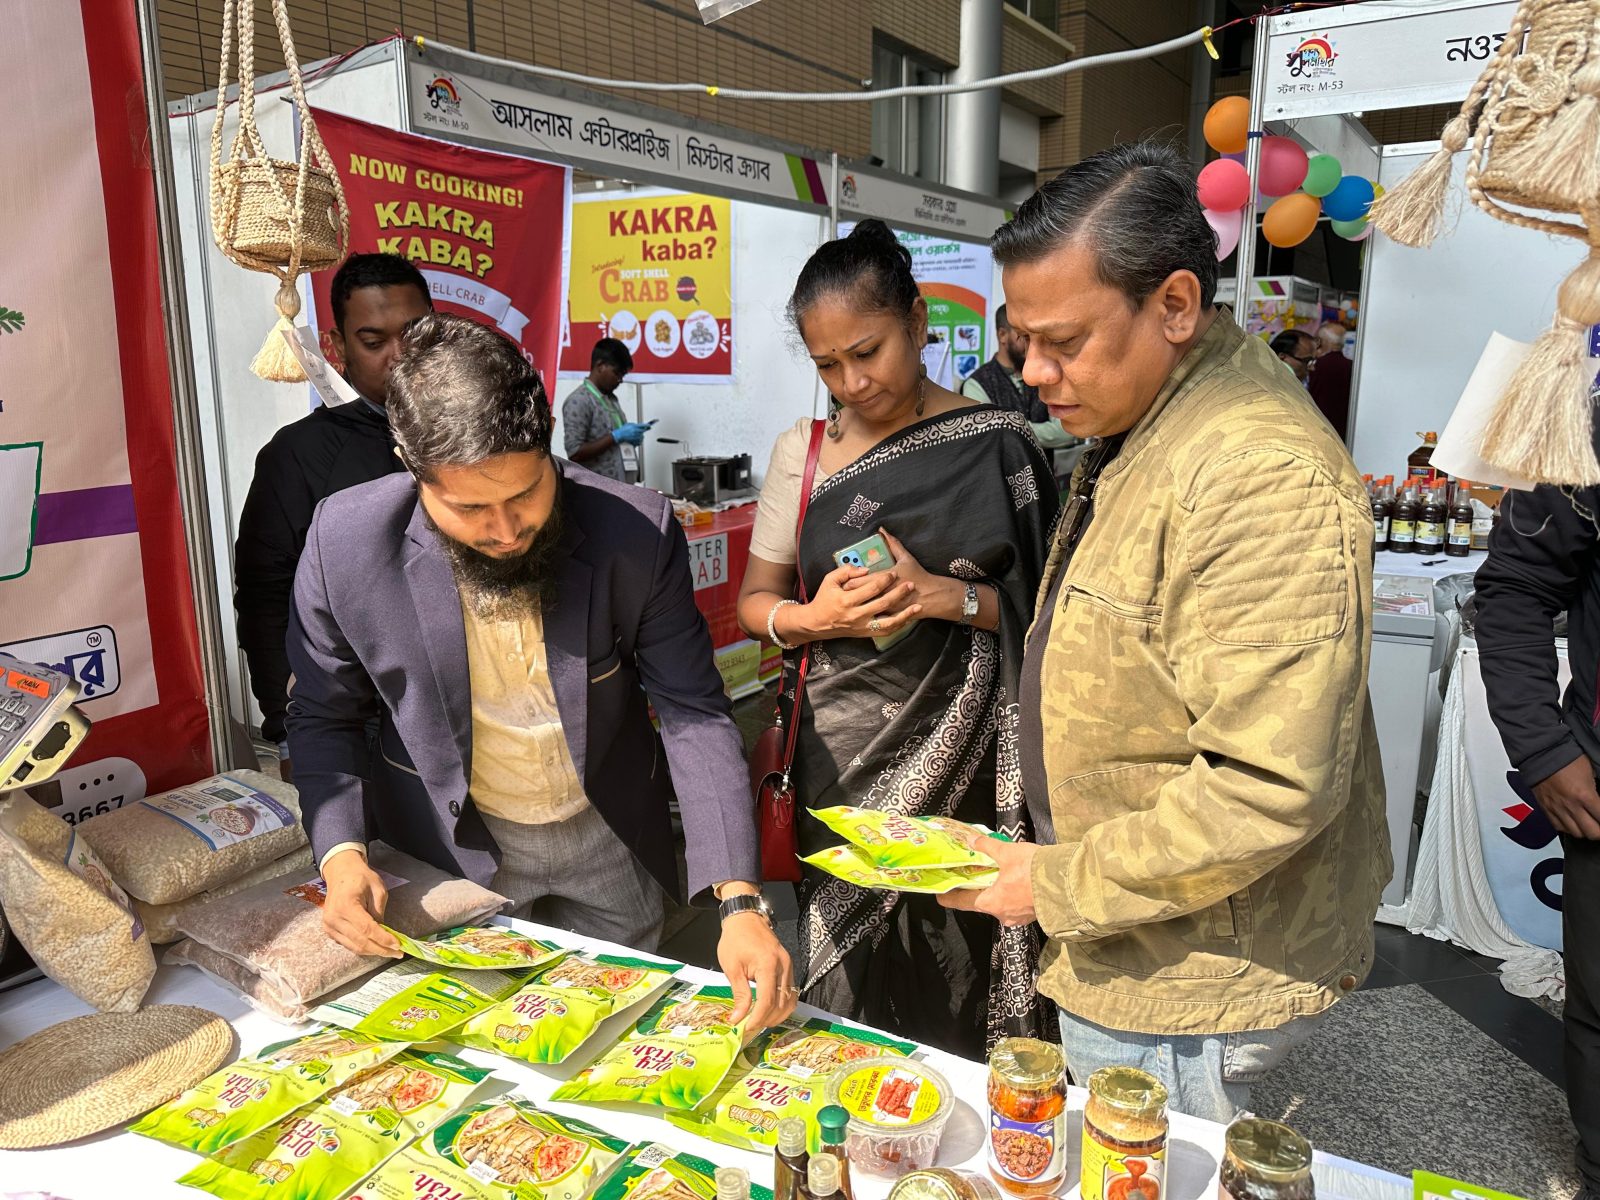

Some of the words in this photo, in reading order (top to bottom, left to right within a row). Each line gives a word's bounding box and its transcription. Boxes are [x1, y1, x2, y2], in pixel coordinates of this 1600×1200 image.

[1318, 80, 1344, 91] M-53
[491, 99, 572, 140] আসলাম
[580, 117, 671, 161] এন্টারপ্রাইজ
[686, 136, 734, 174] মিস্টার
[349, 153, 408, 185] NOW
[415, 169, 524, 208] COOKING!
[374, 201, 495, 249] KAKRA
[609, 204, 717, 237] KAKRA
[376, 236, 494, 279] KABA?
[642, 236, 717, 262] kaba?
[620, 269, 641, 280] SOFT
[643, 268, 670, 279] SHELL
[455, 287, 486, 306] CRAB
[599, 268, 670, 304] CRAB
[512, 1002, 546, 1019] Dry
[631, 1045, 674, 1064] Fish
[634, 1055, 673, 1072] Dry
[225, 1074, 261, 1093] Fish
[745, 1078, 790, 1096] Fish
[218, 1086, 250, 1108] Dry
[747, 1087, 789, 1106] Dry
[280, 1116, 322, 1138] Fish
[275, 1129, 316, 1157] Dry
